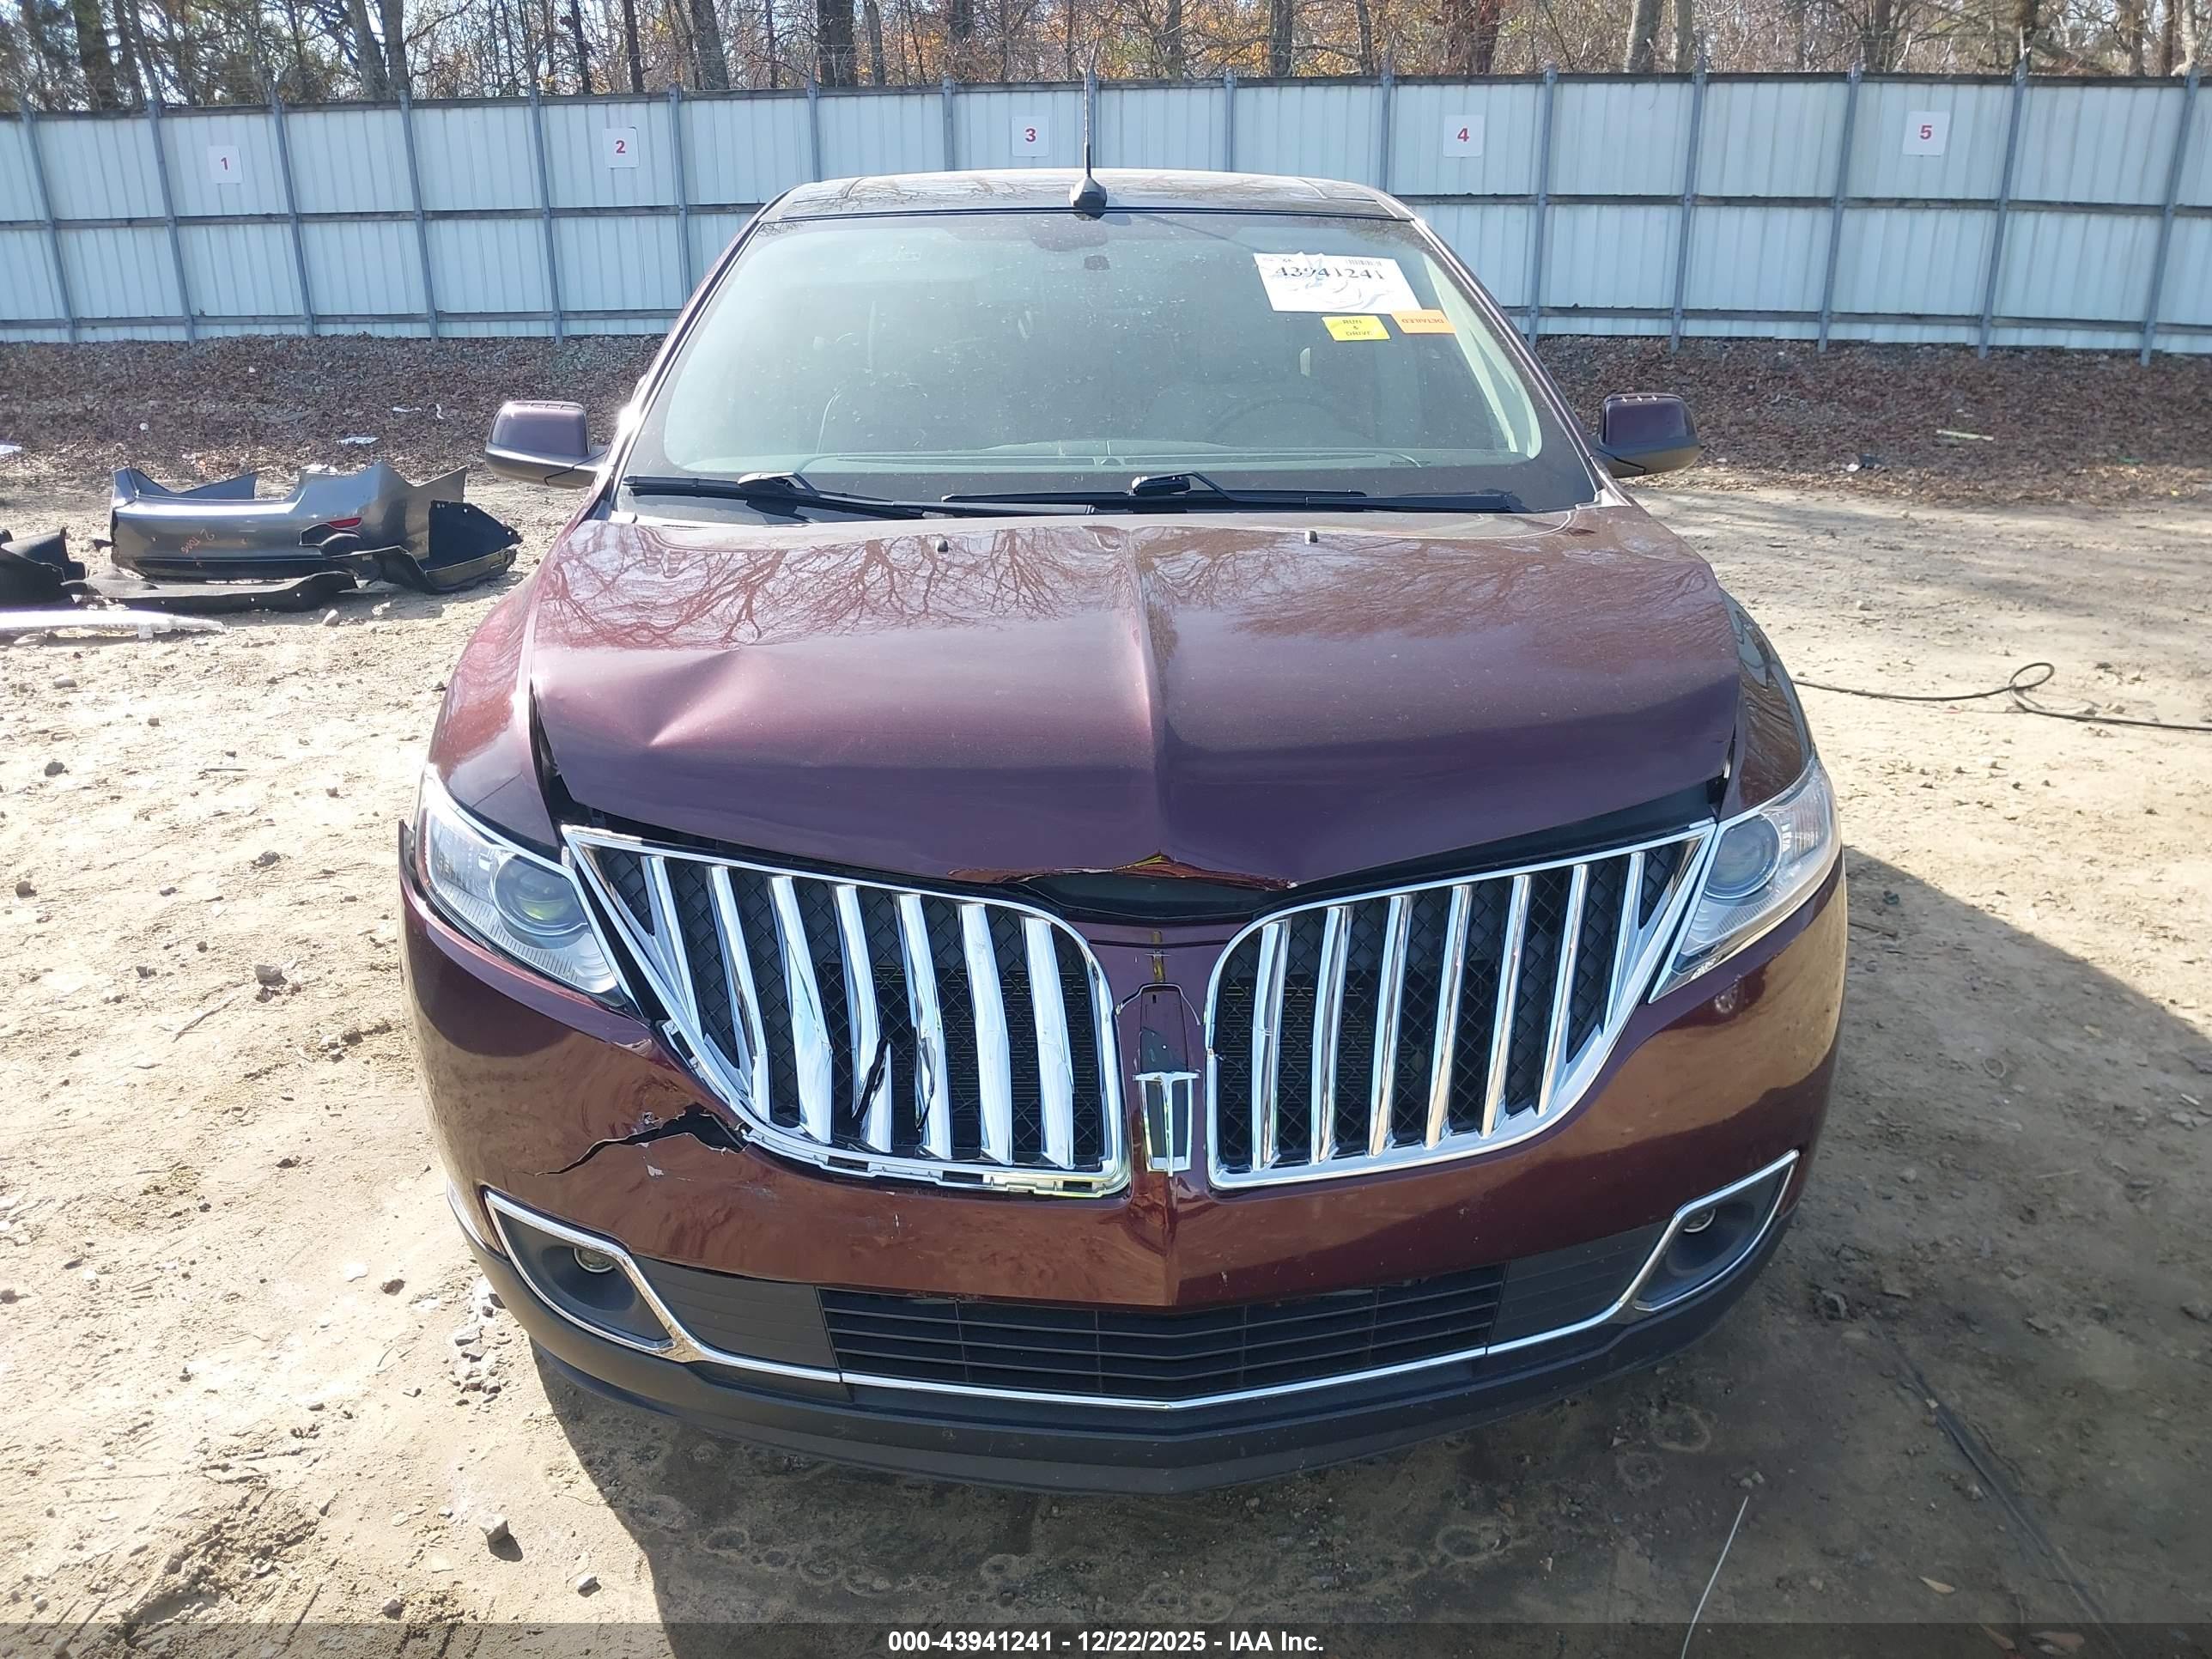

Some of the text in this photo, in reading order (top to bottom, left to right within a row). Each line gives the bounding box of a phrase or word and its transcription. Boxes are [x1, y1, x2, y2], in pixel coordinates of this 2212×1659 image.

[1024, 128, 1036, 143] 3
[1456, 127, 1470, 143] 4
[1919, 125, 1933, 140] 5
[615, 140, 627, 154] 2
[220, 157, 228, 170] 1
[1275, 266, 1386, 280] 43941241
